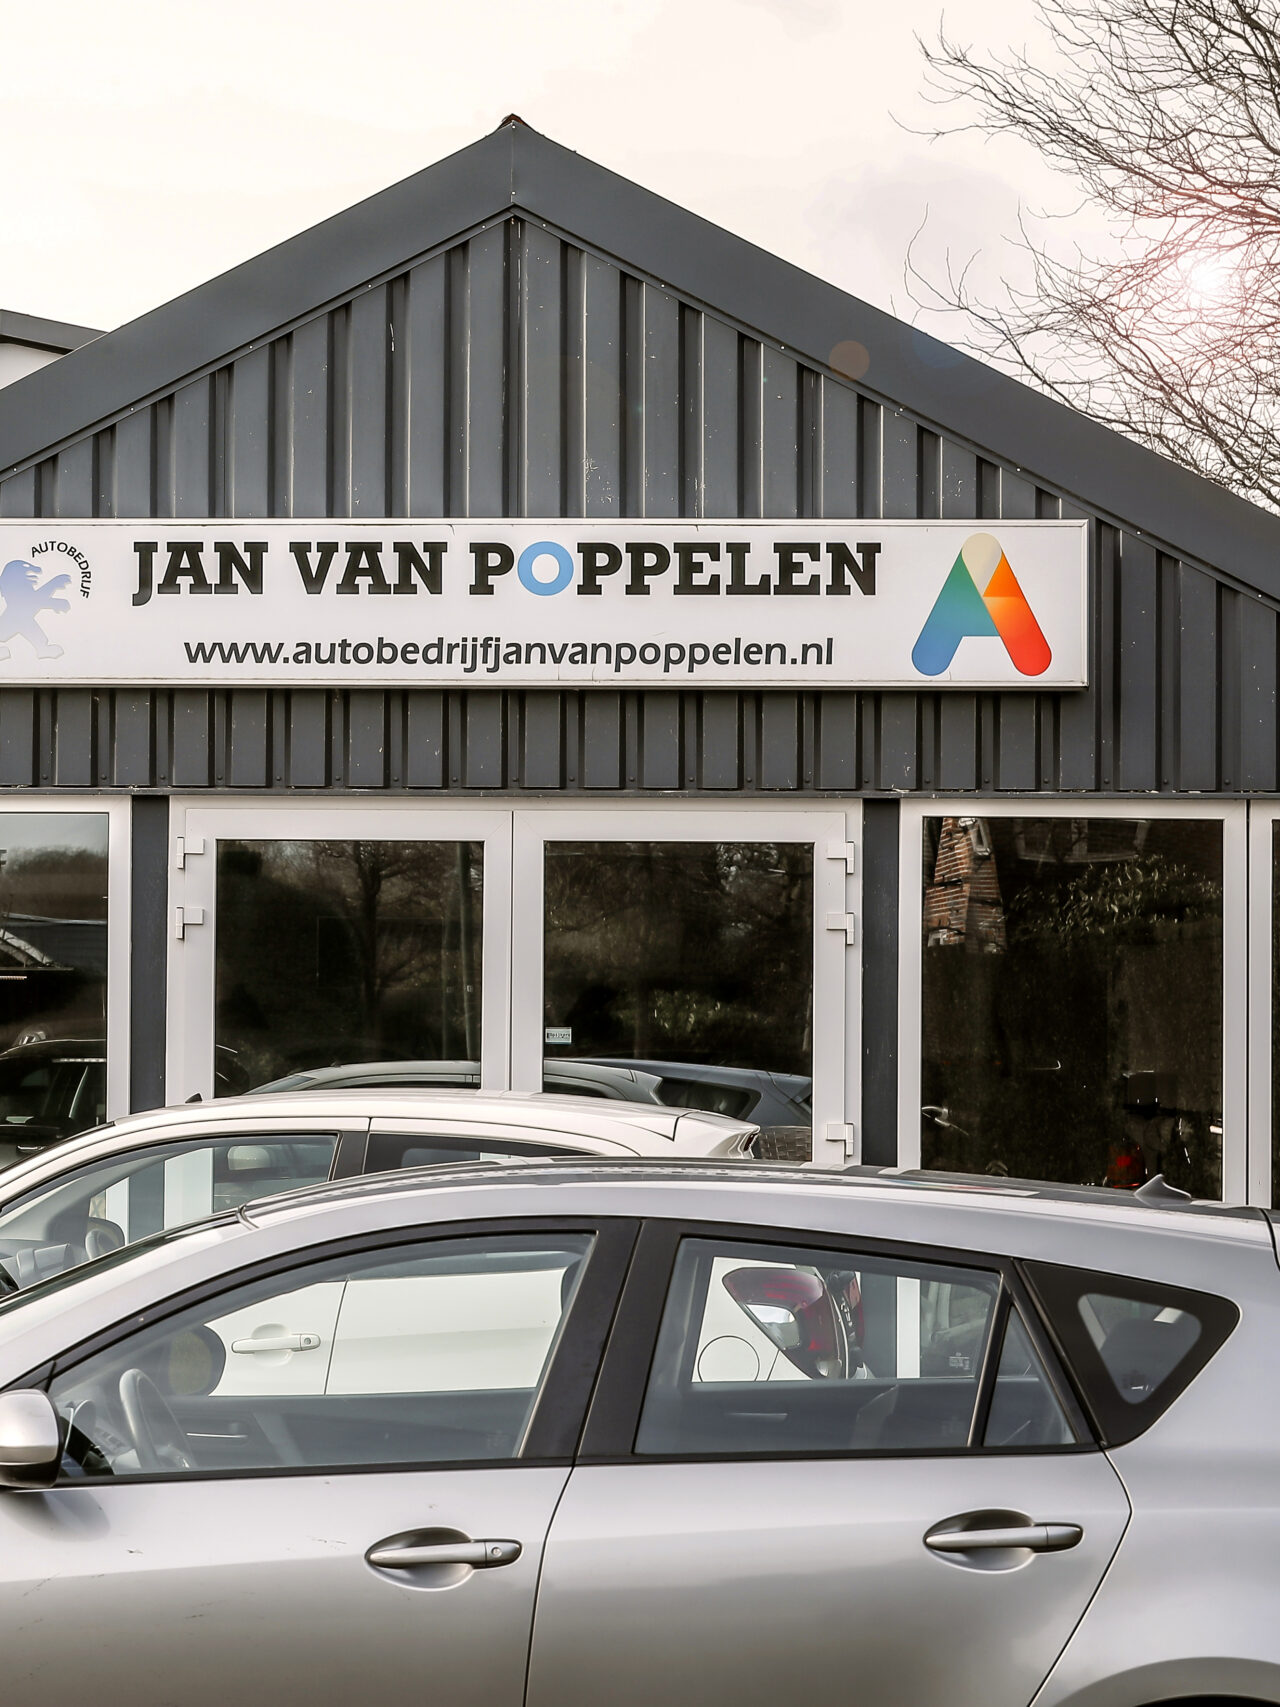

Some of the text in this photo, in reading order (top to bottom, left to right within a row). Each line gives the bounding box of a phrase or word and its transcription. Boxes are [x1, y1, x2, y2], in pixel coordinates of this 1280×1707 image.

[31, 540, 91, 599] AUTOBEDRIJF
[132, 541, 882, 606] JAN VAN POPPELEN
[184, 636, 834, 673] www.autobedrijfjanvanpoppelen.nl
